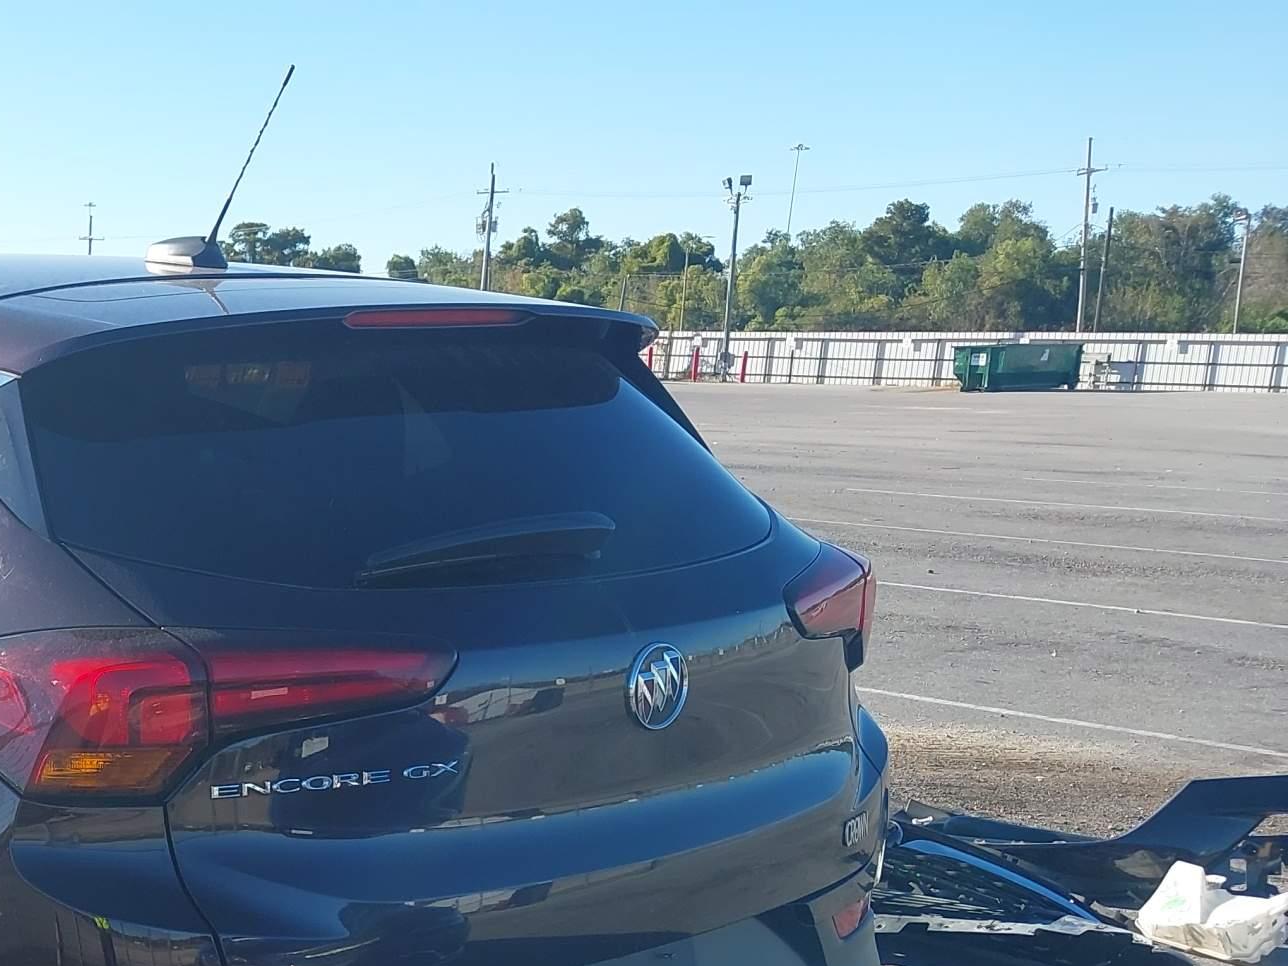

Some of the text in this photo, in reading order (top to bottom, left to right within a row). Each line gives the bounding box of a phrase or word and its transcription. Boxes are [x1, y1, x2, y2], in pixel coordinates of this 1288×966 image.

[210, 760, 459, 800] ENCORE GX
[844, 810, 869, 848] CROWN
